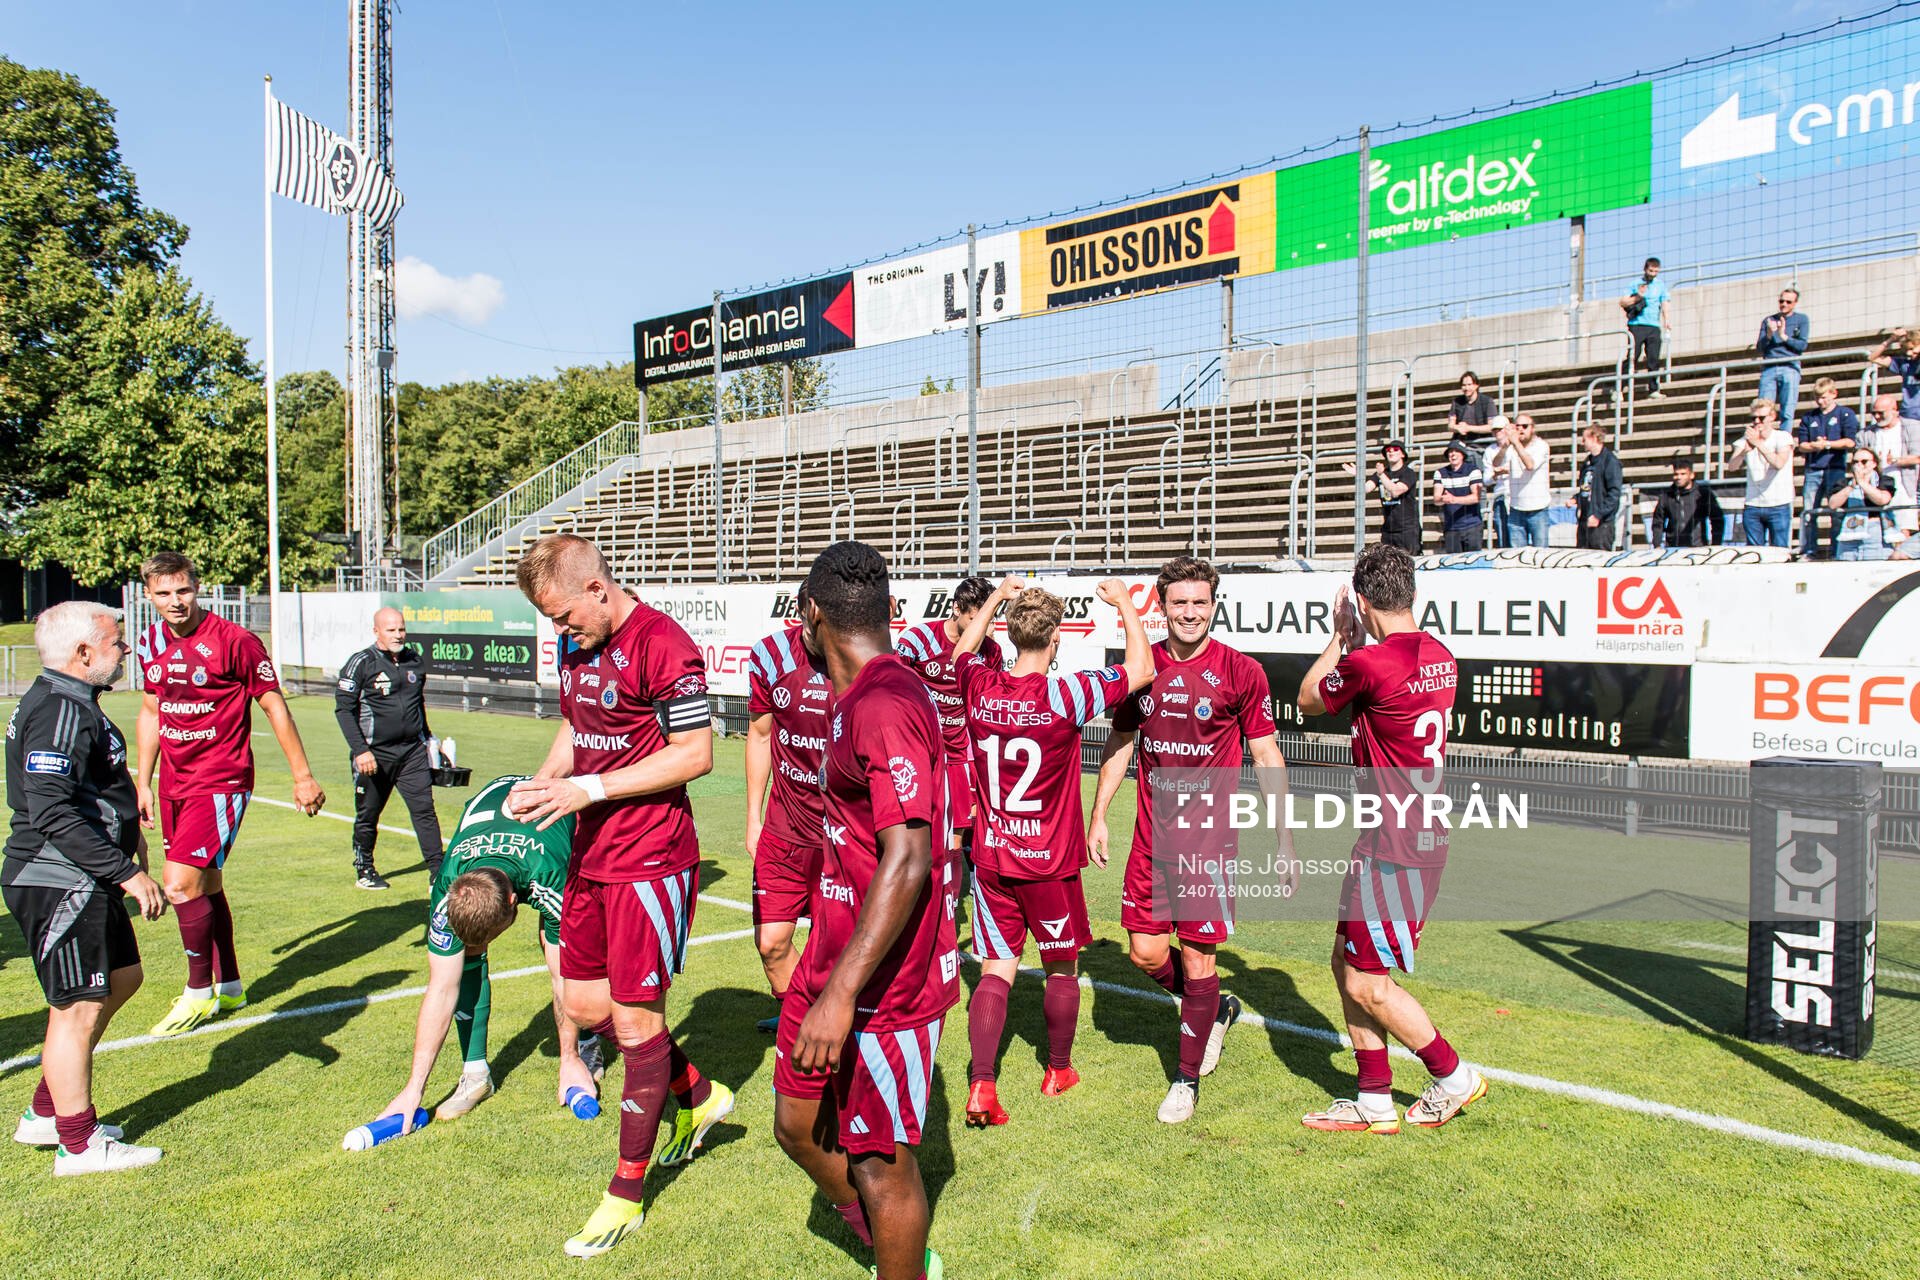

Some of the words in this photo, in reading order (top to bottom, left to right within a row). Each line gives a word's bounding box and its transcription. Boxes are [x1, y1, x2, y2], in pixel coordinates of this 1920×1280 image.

[1386, 152, 1537, 215] alfdex
[1367, 221, 1411, 241] reener
[1413, 217, 1431, 232] by
[1434, 196, 1532, 230] g-Technology
[1050, 217, 1204, 287] OHLSSONS
[867, 273, 884, 286] THE
[887, 265, 925, 281] ORIGINAL
[643, 294, 806, 360] InfoChannel
[667, 355, 716, 374] KOMMUNIKATI
[722, 351, 738, 363] NÄR
[738, 348, 754, 360] DEN
[754, 345, 765, 357] ÄR
[765, 342, 784, 353] SOM
[784, 337, 806, 350] BÄST!
[1118, 583, 1162, 617] CA
[1597, 576, 1682, 619] ICA
[417, 606, 443, 622] nästa
[443, 604, 495, 625] generation
[1638, 620, 1684, 636] nära
[432, 638, 461, 660] akea
[484, 640, 516, 663] akea
[1596, 639, 1684, 653] Häljarpshallen
[611, 647, 630, 671] 1882
[1201, 669, 1221, 688] 1882
[1419, 661, 1455, 680] NORDIC
[160, 701, 215, 715] SANDVIK
[980, 695, 1036, 713] NORDIC
[971, 706, 1052, 727] WELLNESS
[1479, 709, 1622, 748] Consulting
[1153, 740, 1215, 757] SANDVIK
[1410, 707, 1453, 796] 3
[1752, 731, 1828, 753] Befesa
[30, 755, 70, 767] UNIBET
[790, 767, 818, 785] Gävle
[977, 733, 1043, 812] 12
[1770, 810, 1839, 1028] SELECT
[89, 973, 105, 988] JG
